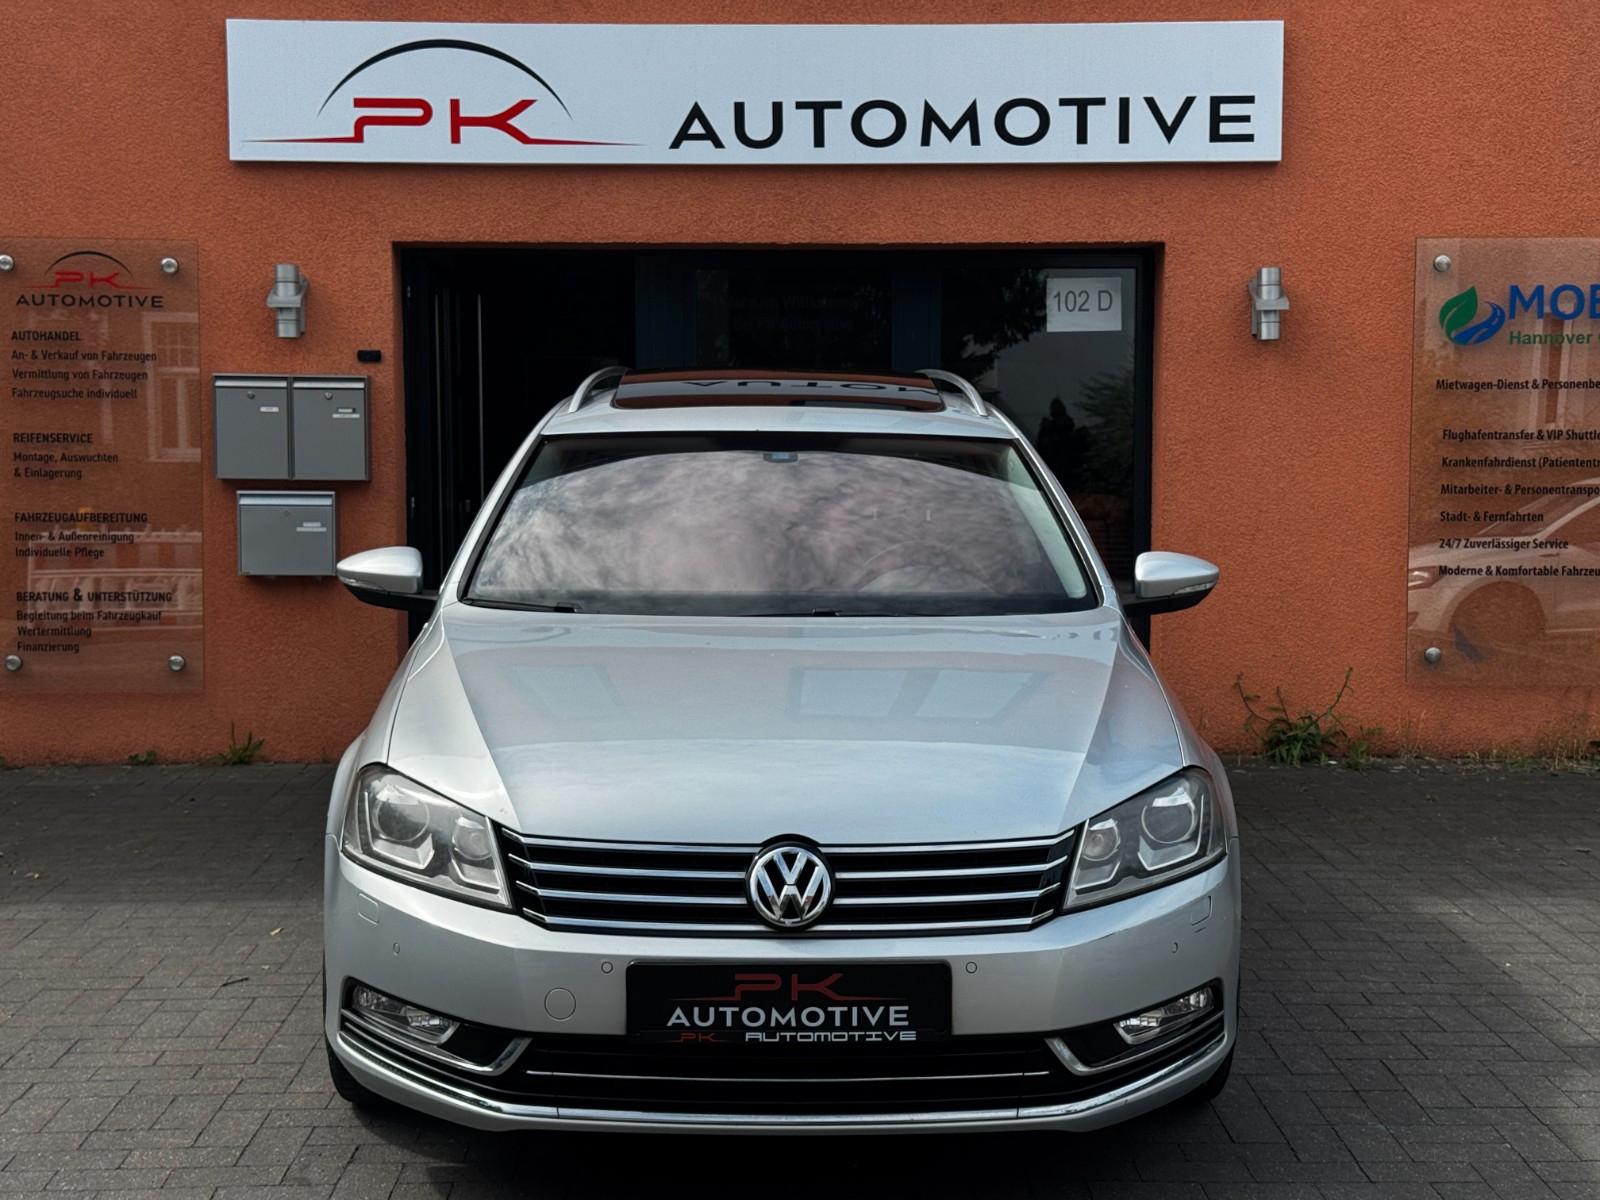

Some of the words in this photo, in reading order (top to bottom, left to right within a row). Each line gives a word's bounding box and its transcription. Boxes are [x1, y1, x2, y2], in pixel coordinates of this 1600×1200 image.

[353, 96, 538, 145] PK
[668, 94, 1256, 150] AUTOMOTIVE
[55, 271, 120, 289] PK
[16, 293, 164, 308] AUTOMOTIVE
[1053, 289, 1090, 313] 102
[1098, 289, 1113, 312] D
[11, 330, 81, 341] AUTOHANDEL
[1509, 331, 1593, 345] Hannover
[11, 350, 28, 360] An-
[31, 350, 39, 360] &
[42, 350, 79, 361] Verkauf
[81, 353, 99, 361] von
[101, 351, 157, 364] Fahrzeugen
[12, 368, 69, 381] Vermittlung
[72, 371, 90, 380] von
[92, 369, 148, 382] Fahrzeugen
[1436, 378, 1530, 392] Mietwagen-Dienst
[1532, 379, 1539, 389] &
[1542, 378, 1600, 389] Personenbe
[12, 387, 84, 400] Fahrzeugsuche
[87, 387, 138, 399] individuell
[13, 432, 93, 444] REIFENSERVICE
[1442, 429, 1534, 443] Flughafentransfer
[1536, 430, 1544, 440] &
[1545, 429, 1563, 440] VIP
[13, 452, 58, 464] Montage,
[60, 452, 119, 463] Auswuchten
[1441, 456, 1536, 468] Krankenfahrdienst
[14, 468, 22, 478] &
[24, 467, 82, 480] Einlagerung
[1440, 484, 1502, 495] Mitarbeiter-
[1504, 484, 1512, 495] &
[1514, 484, 1600, 497] Personentranspo
[15, 512, 148, 523] FAHRZEUGAUFBEREITUNG
[1440, 511, 1472, 522] Stadt-
[1473, 512, 1481, 522] &
[1483, 511, 1544, 522] Fernfahrten
[15, 531, 46, 542] Innen-
[48, 531, 56, 541] &
[58, 531, 135, 543] Außenreinigung
[1439, 538, 1461, 549] 24/7
[1464, 538, 1530, 552] Zuverlässiger
[1532, 538, 1569, 550] Service
[15, 547, 72, 558] Individuelle
[75, 547, 105, 559] Pflege
[1438, 565, 1484, 577] Moderne
[1486, 565, 1494, 576] &
[1495, 565, 1559, 576] Komfortable
[1561, 565, 1600, 577] Fahrzeu
[16, 591, 70, 602] BERATUNG
[73, 588, 83, 601] &
[87, 590, 173, 602] UNTERSTÜTZUNG
[16, 610, 69, 622] Begleitung
[71, 610, 95, 621] beim
[96, 610, 162, 623] Fahrzeugkauf
[17, 627, 92, 638] Wertermittlung
[17, 641, 80, 653] Finanzierung
[734, 972, 845, 1001] PK
[666, 1005, 910, 1028] AUTOMOTIVE
[680, 1032, 717, 1043] PK
[745, 1030, 917, 1042] AUTOMOTIVE
